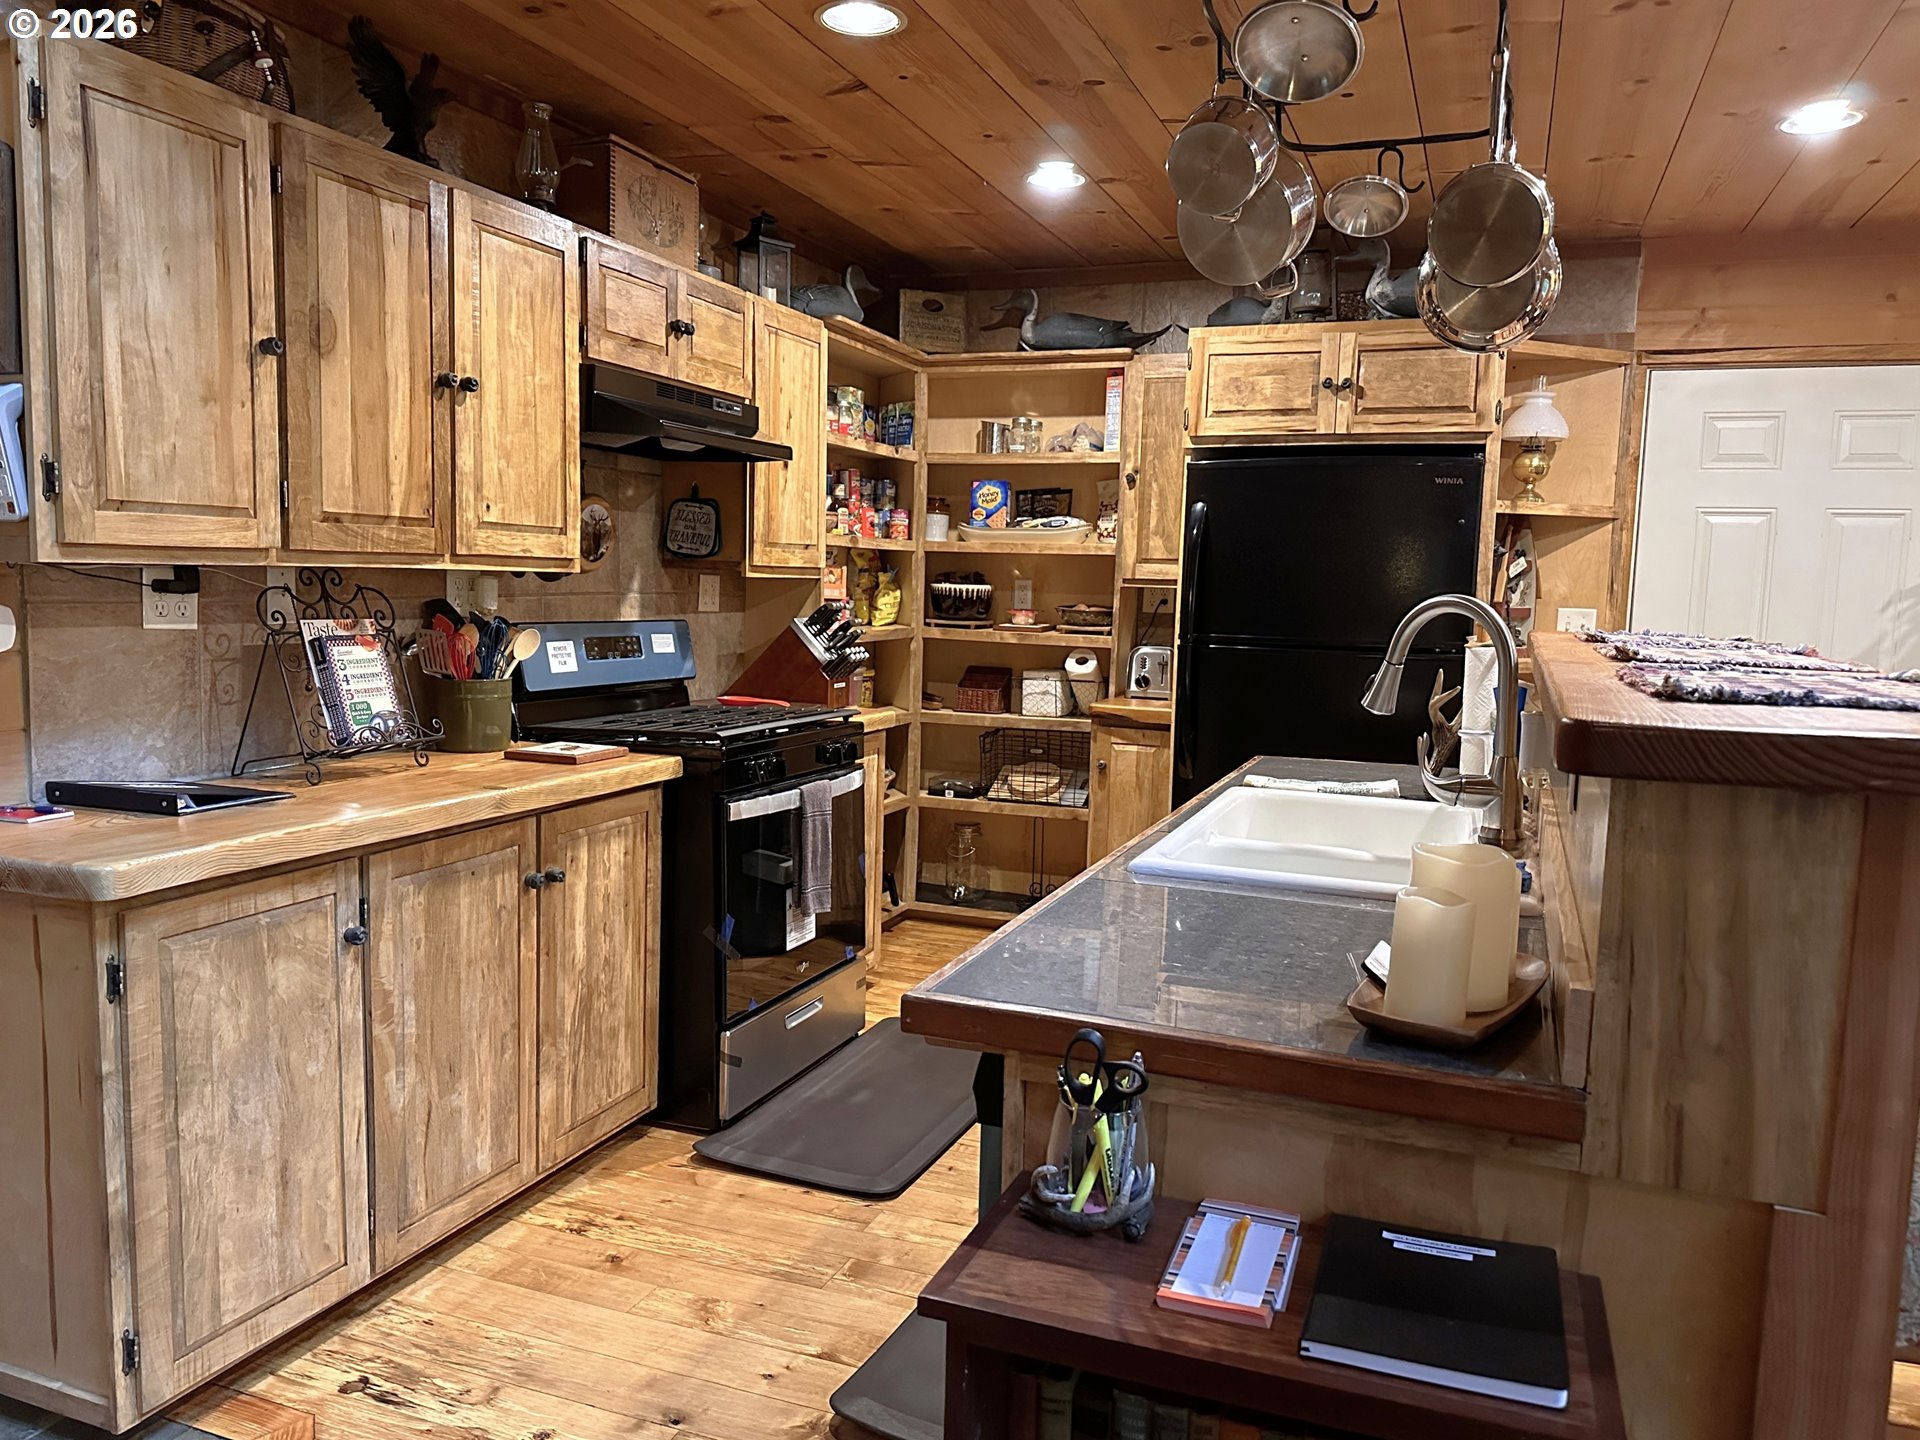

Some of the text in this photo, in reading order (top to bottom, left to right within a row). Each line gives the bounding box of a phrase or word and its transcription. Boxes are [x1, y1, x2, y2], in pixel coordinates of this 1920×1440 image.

[1434, 477, 1464, 485] WINIA
[978, 490, 999, 500] Honey
[981, 497, 998, 505] Maid
[675, 509, 711, 525] BLESSED
[670, 529, 711, 547] THANKFUL
[303, 621, 338, 637] Taste
[337, 657, 379, 671] 3 INGREDIENT
[341, 671, 383, 686] 4 INGREDIENT
[345, 686, 387, 701] 5 INGREDIENT
